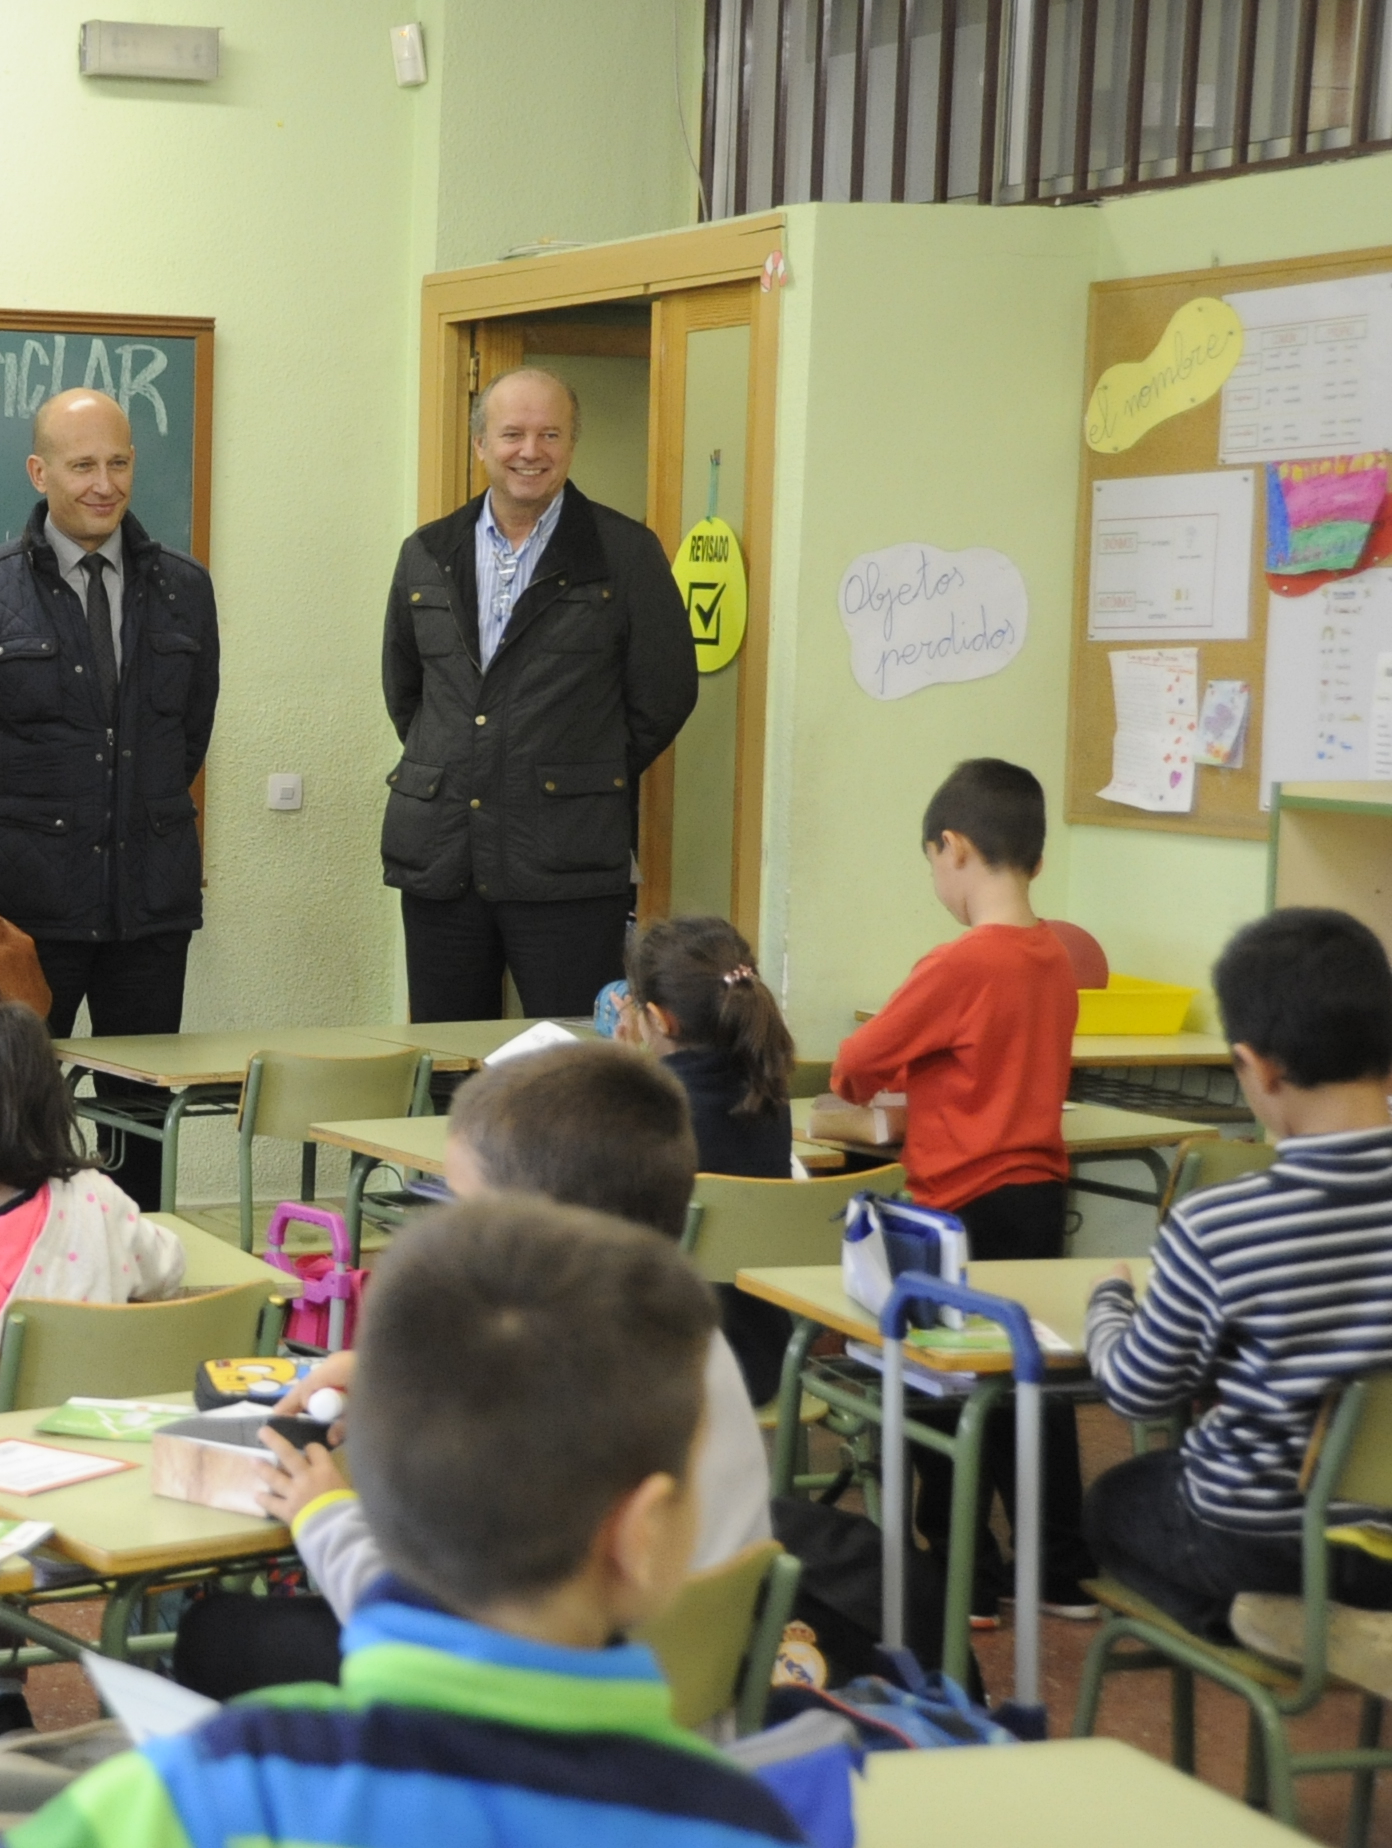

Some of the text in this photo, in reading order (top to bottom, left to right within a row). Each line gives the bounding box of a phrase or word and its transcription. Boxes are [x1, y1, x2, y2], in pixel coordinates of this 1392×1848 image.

[1122, 331, 1230, 417] nombre
[689, 535, 729, 563] REVISADO
[844, 549, 965, 641] Objetos
[875, 605, 1015, 695] perdidos
